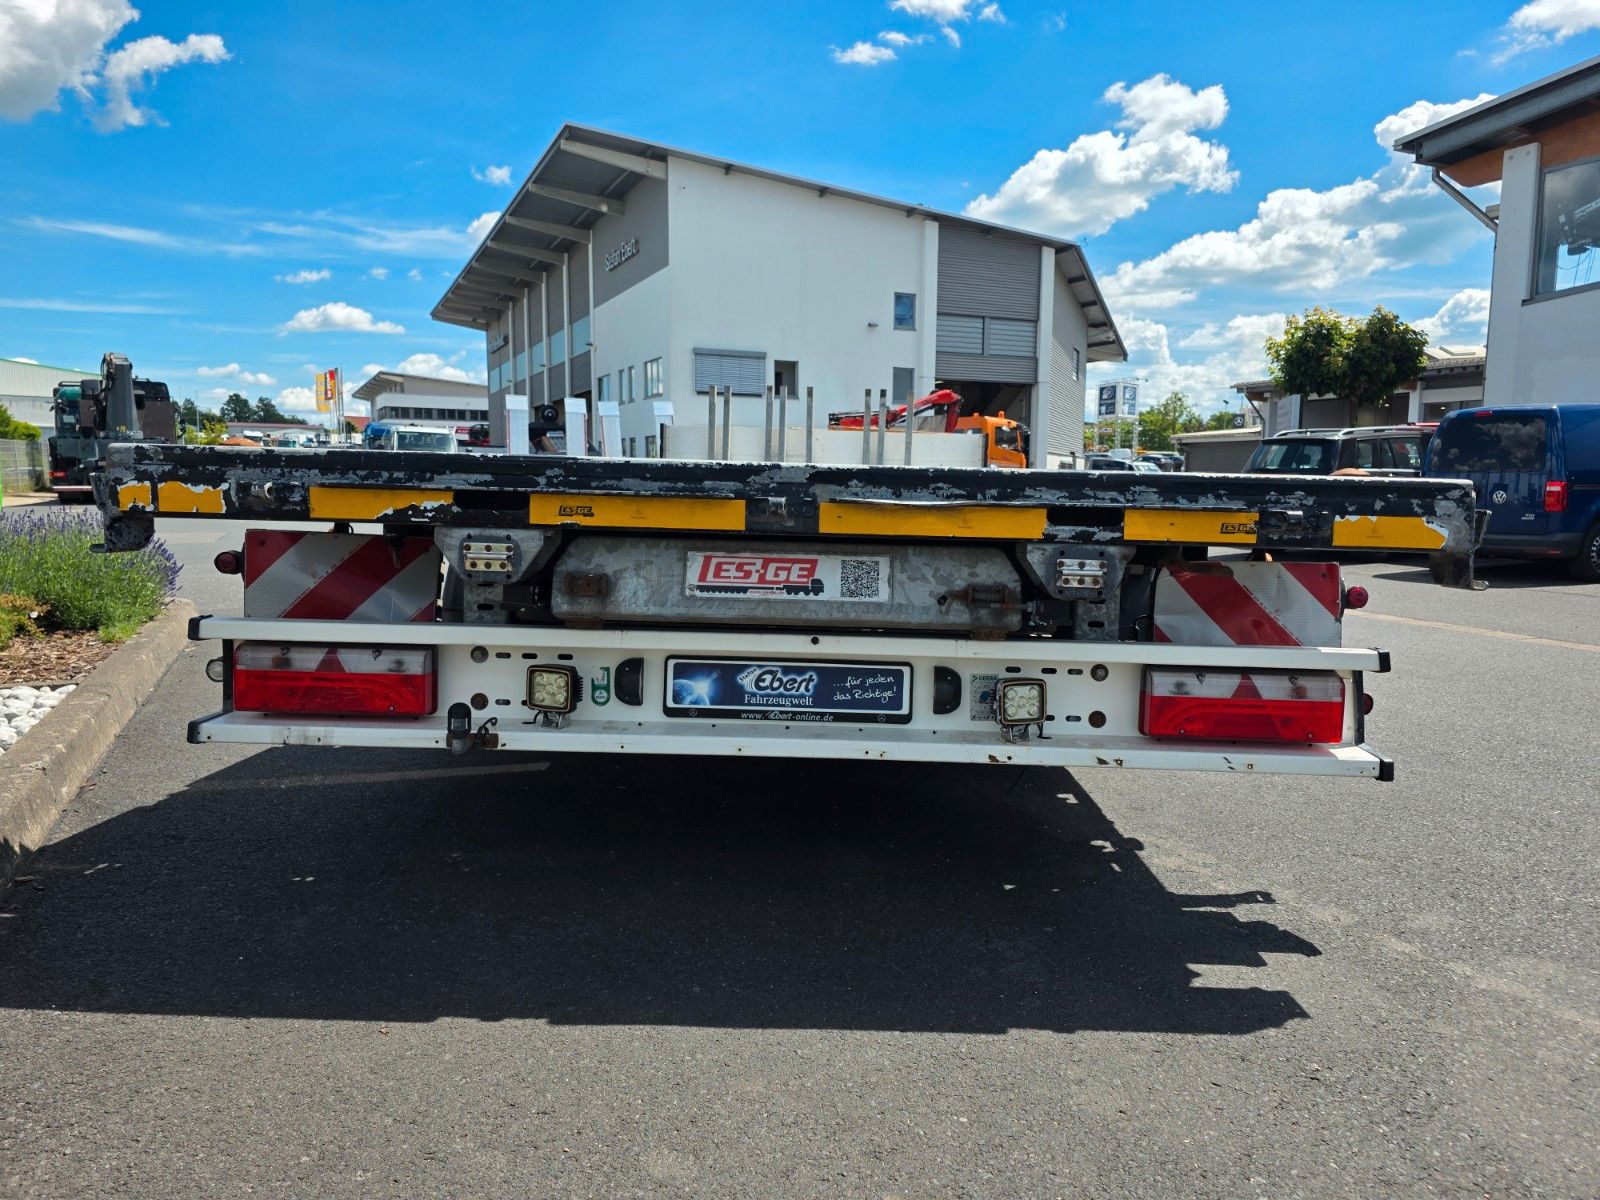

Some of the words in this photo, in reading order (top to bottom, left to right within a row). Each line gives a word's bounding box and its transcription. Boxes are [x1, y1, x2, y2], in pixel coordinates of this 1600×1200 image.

[739, 668, 757, 682] Stefan
[754, 669, 815, 693] Ebert
[865, 674, 894, 686] jeden
[744, 694, 813, 707] Fahrzeugwelt
[833, 691, 851, 701] das
[852, 685, 897, 703] Richtige!
